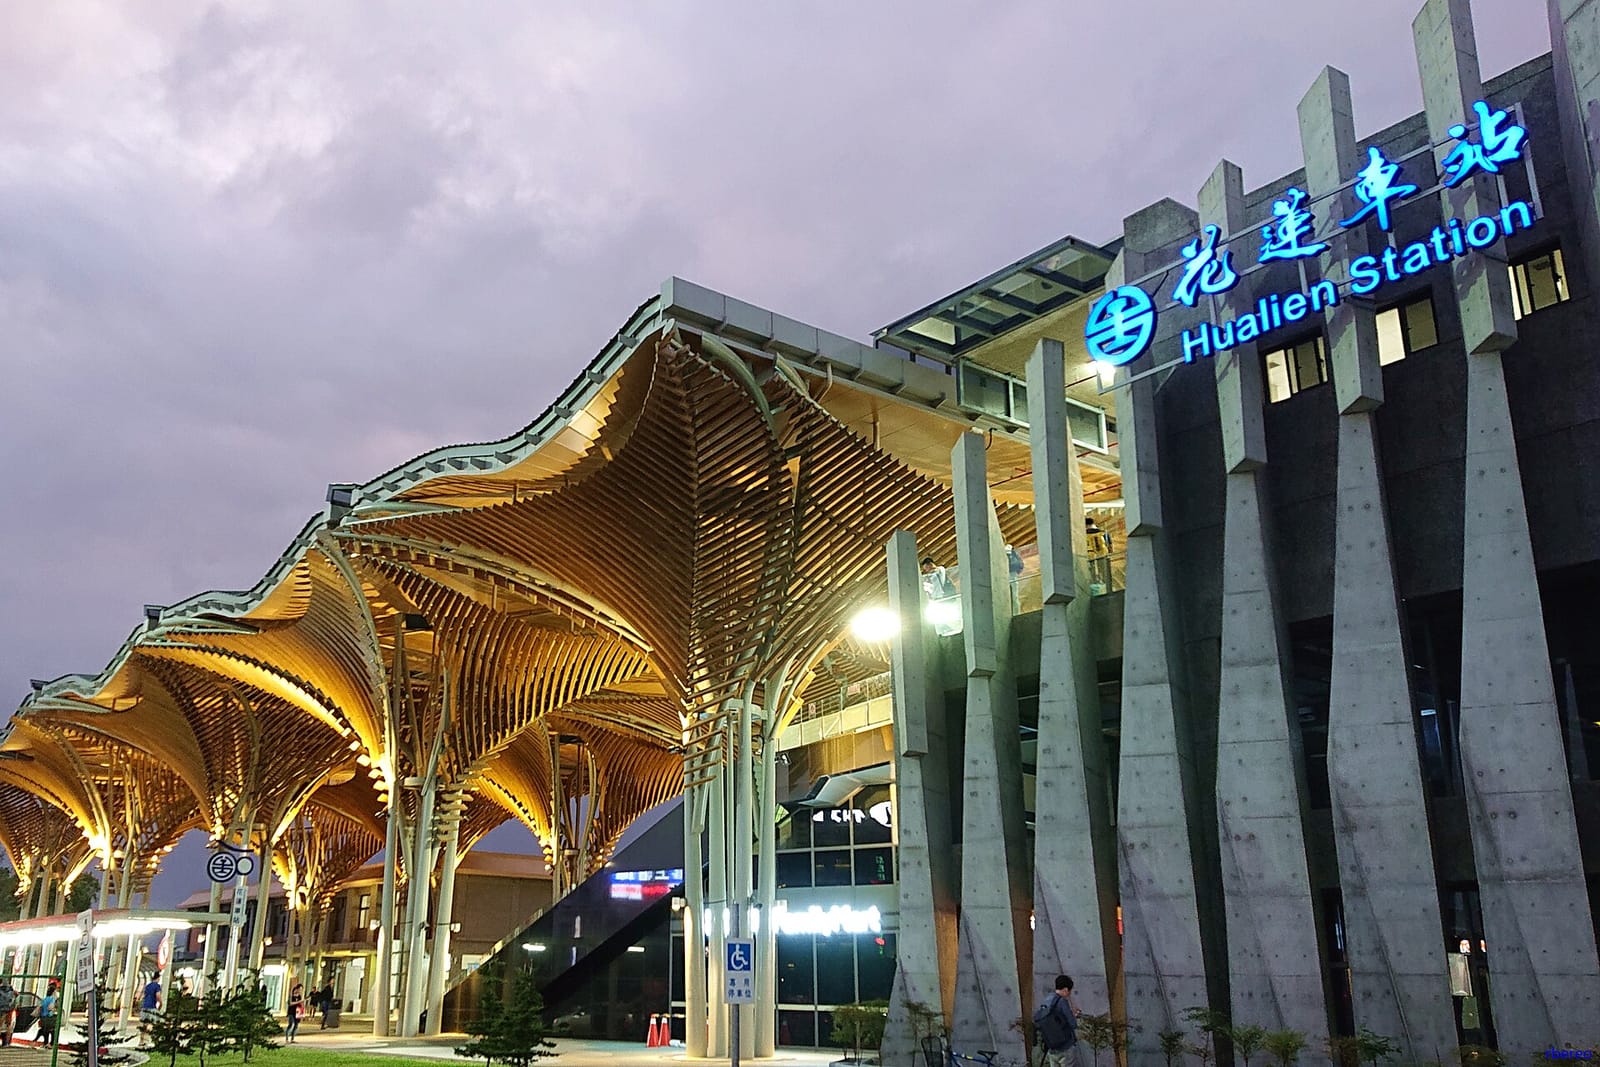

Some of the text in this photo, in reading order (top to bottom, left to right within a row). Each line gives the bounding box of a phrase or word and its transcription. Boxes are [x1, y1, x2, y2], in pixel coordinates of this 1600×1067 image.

[1172, 101, 1527, 309] 花蓮車站
[1181, 200, 1534, 364] Hualien Station
